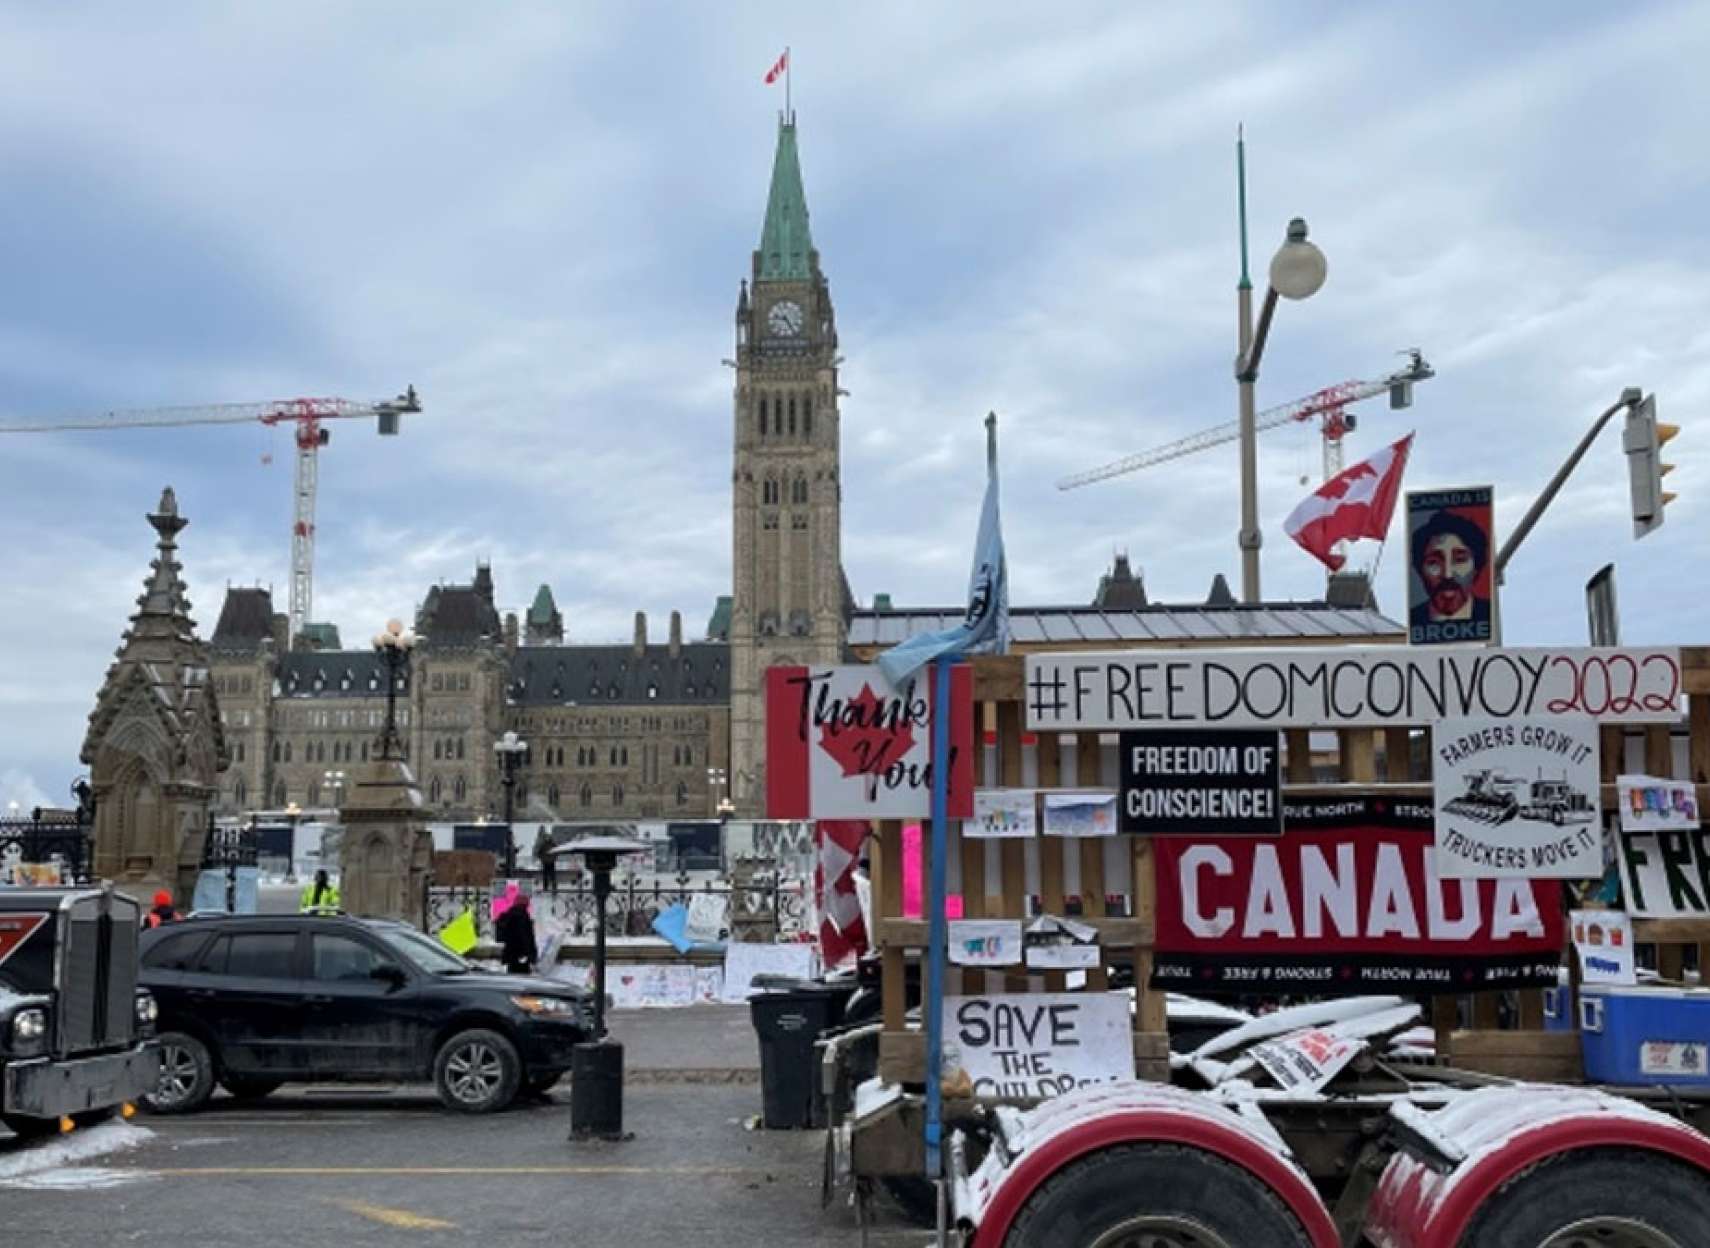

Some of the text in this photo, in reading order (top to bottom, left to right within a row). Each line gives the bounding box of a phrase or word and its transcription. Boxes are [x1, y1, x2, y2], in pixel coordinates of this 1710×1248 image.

[1411, 620, 1489, 642] BROKE
[786, 671, 931, 742] Thank
[1029, 653, 1680, 721] #FREEDOMCONVOY2022
[1132, 746, 1273, 775] FREEDOM OF
[1440, 724, 1593, 767] FARMERS GROW IT
[1126, 788, 1274, 818] CONSCIENCE!
[1442, 827, 1595, 869] TRUCKERS MOVE IT
[1179, 842, 1545, 940] CANADA
[957, 999, 1080, 1047] SAVE
[992, 1051, 1053, 1076] THE
